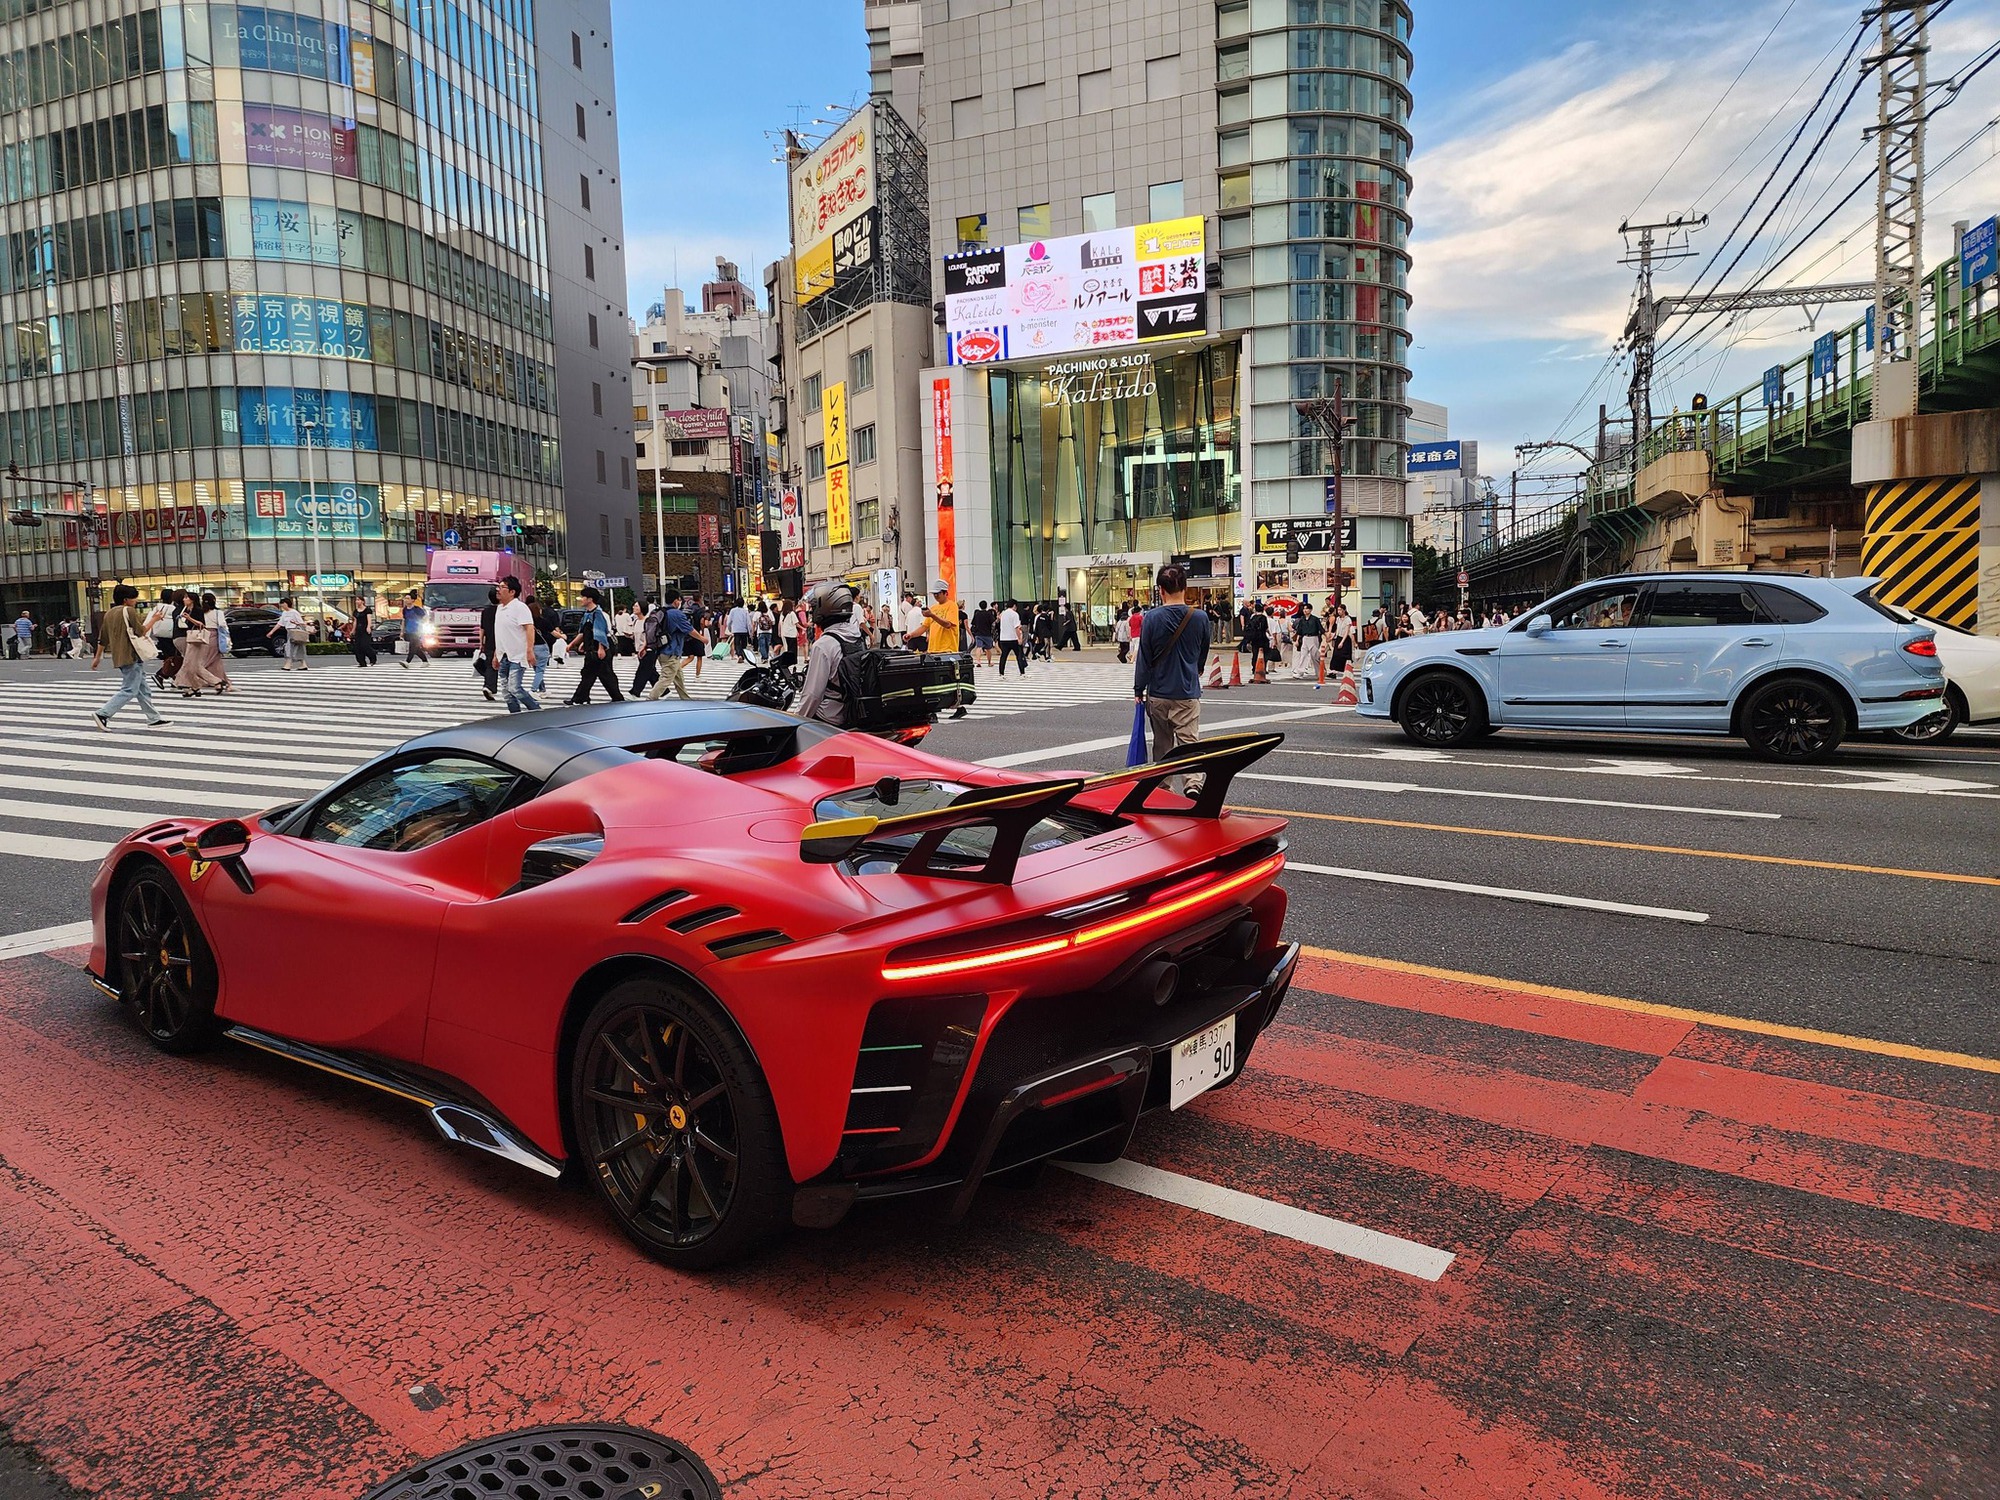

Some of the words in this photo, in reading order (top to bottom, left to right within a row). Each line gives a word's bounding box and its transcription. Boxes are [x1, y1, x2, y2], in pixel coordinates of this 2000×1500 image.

[223, 22, 249, 40] La
[252, 25, 339, 56] Clinique
[293, 124, 345, 146] PIONE
[822, 133, 859, 183] カラオケ
[818, 165, 867, 232] まねきねこ
[274, 209, 355, 240] 桜十字
[947, 262, 968, 271] LOUNGE
[965, 262, 1001, 277] CARROT
[1180, 257, 1198, 290] 焼肉
[1073, 288, 1133, 310] ルノアール
[235, 299, 364, 327] 東京内視鏡
[1097, 317, 1128, 328] カラオケ
[240, 320, 363, 342] クリニック
[1092, 328, 1134, 345] まねきねこ
[1049, 359, 1108, 375] PACHINKO
[1110, 358, 1118, 367] &
[1121, 354, 1151, 367] SLOT
[295, 393, 320, 402] SBC
[1044, 368, 1157, 406] Kaleido
[253, 402, 364, 430] 新宿近視
[260, 494, 282, 514] 薬
[302, 499, 364, 515] welcia
[1271, 528, 1287, 539] 7F
[1090, 554, 1128, 567] Kaleido
[1208, 1024, 1224, 1048] 337
[1175, 1079, 1185, 1090] つ
[1213, 1040, 1232, 1079] 90
